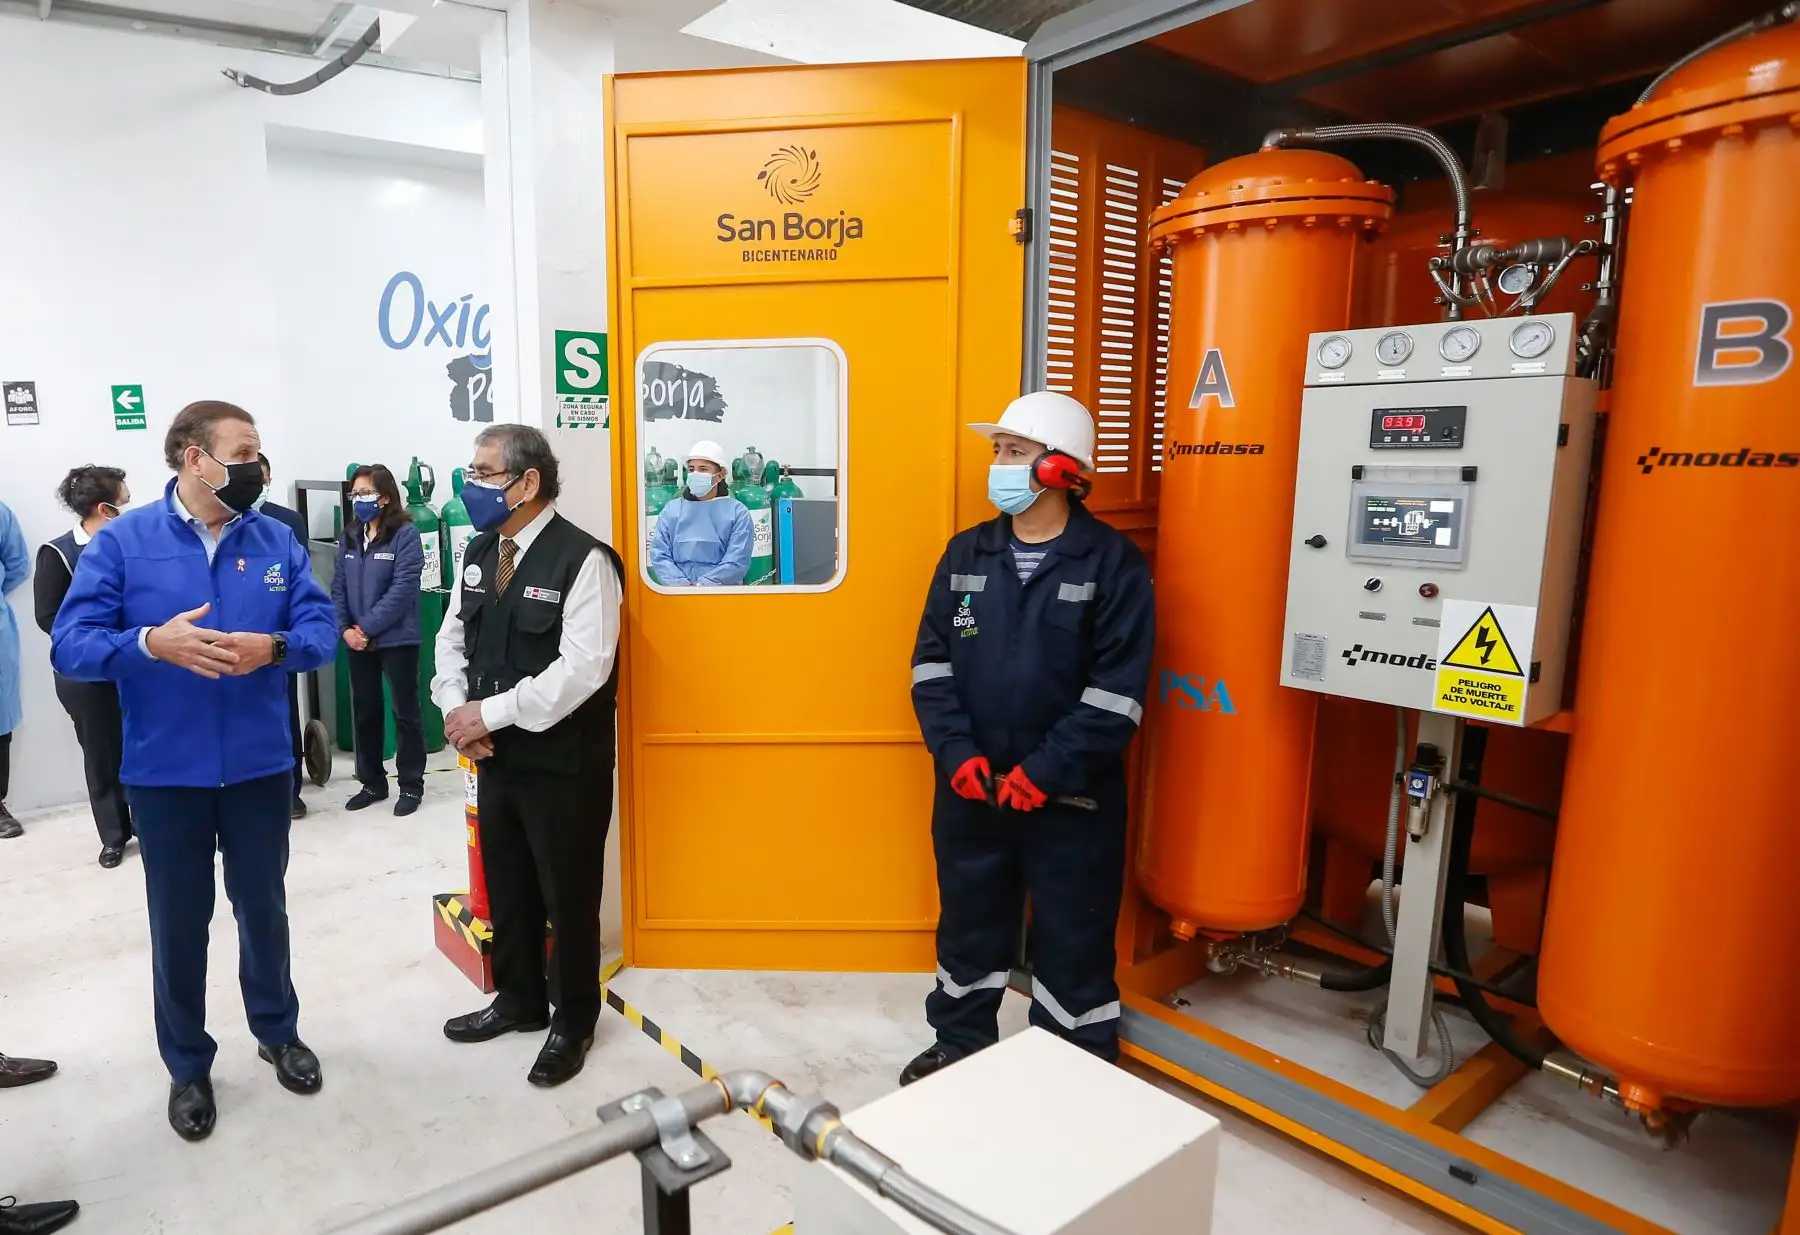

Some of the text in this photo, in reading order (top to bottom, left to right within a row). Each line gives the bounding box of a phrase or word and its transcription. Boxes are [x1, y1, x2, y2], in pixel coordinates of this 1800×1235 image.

[716, 210, 864, 248] San Borja
[742, 249, 838, 262] BICENTENARIO
[1692, 298, 1794, 387] B
[563, 337, 602, 389] S
[1188, 348, 1237, 410] A
[643, 372, 705, 420] orja
[116, 418, 145, 426] SALIDA
[1176, 441, 1265, 455] modasa
[424, 551, 435, 560] an
[422, 560, 439, 572] orja
[266, 569, 281, 577] San
[263, 576, 284, 585] Borja
[958, 607, 971, 617] San
[953, 616, 975, 628] Borja
[1458, 679, 1502, 692] PELIGRO
[1160, 670, 1239, 715] PSA
[1450, 686, 1508, 701] DE MUERTE
[1441, 694, 1515, 712] ALTO VOLTAJE
